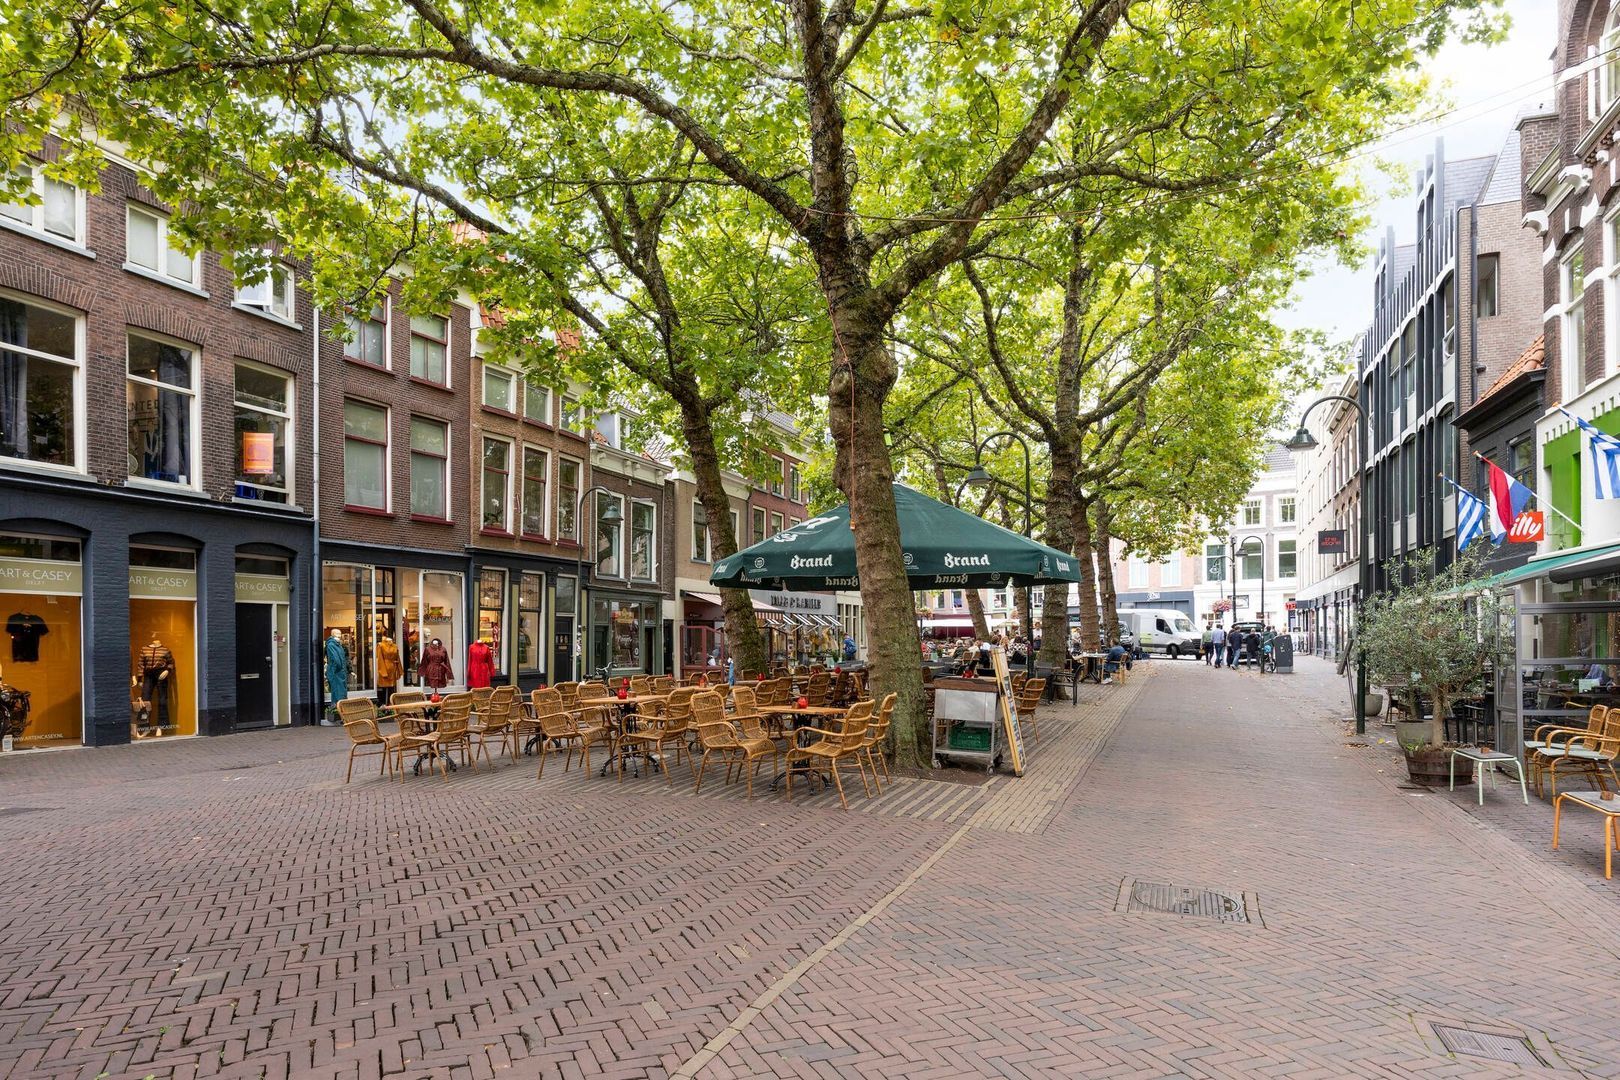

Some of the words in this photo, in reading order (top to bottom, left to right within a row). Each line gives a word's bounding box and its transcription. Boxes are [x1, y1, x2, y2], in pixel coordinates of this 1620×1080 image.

[1510, 514, 1542, 540] illy
[790, 554, 833, 570] Brand
[944, 552, 991, 568] Brand
[0, 567, 21, 578] ART
[32, 569, 72, 581] CASEY
[129, 575, 147, 585] ART
[156, 576, 188, 587] CASEY
[256, 582, 283, 592] CASEY
